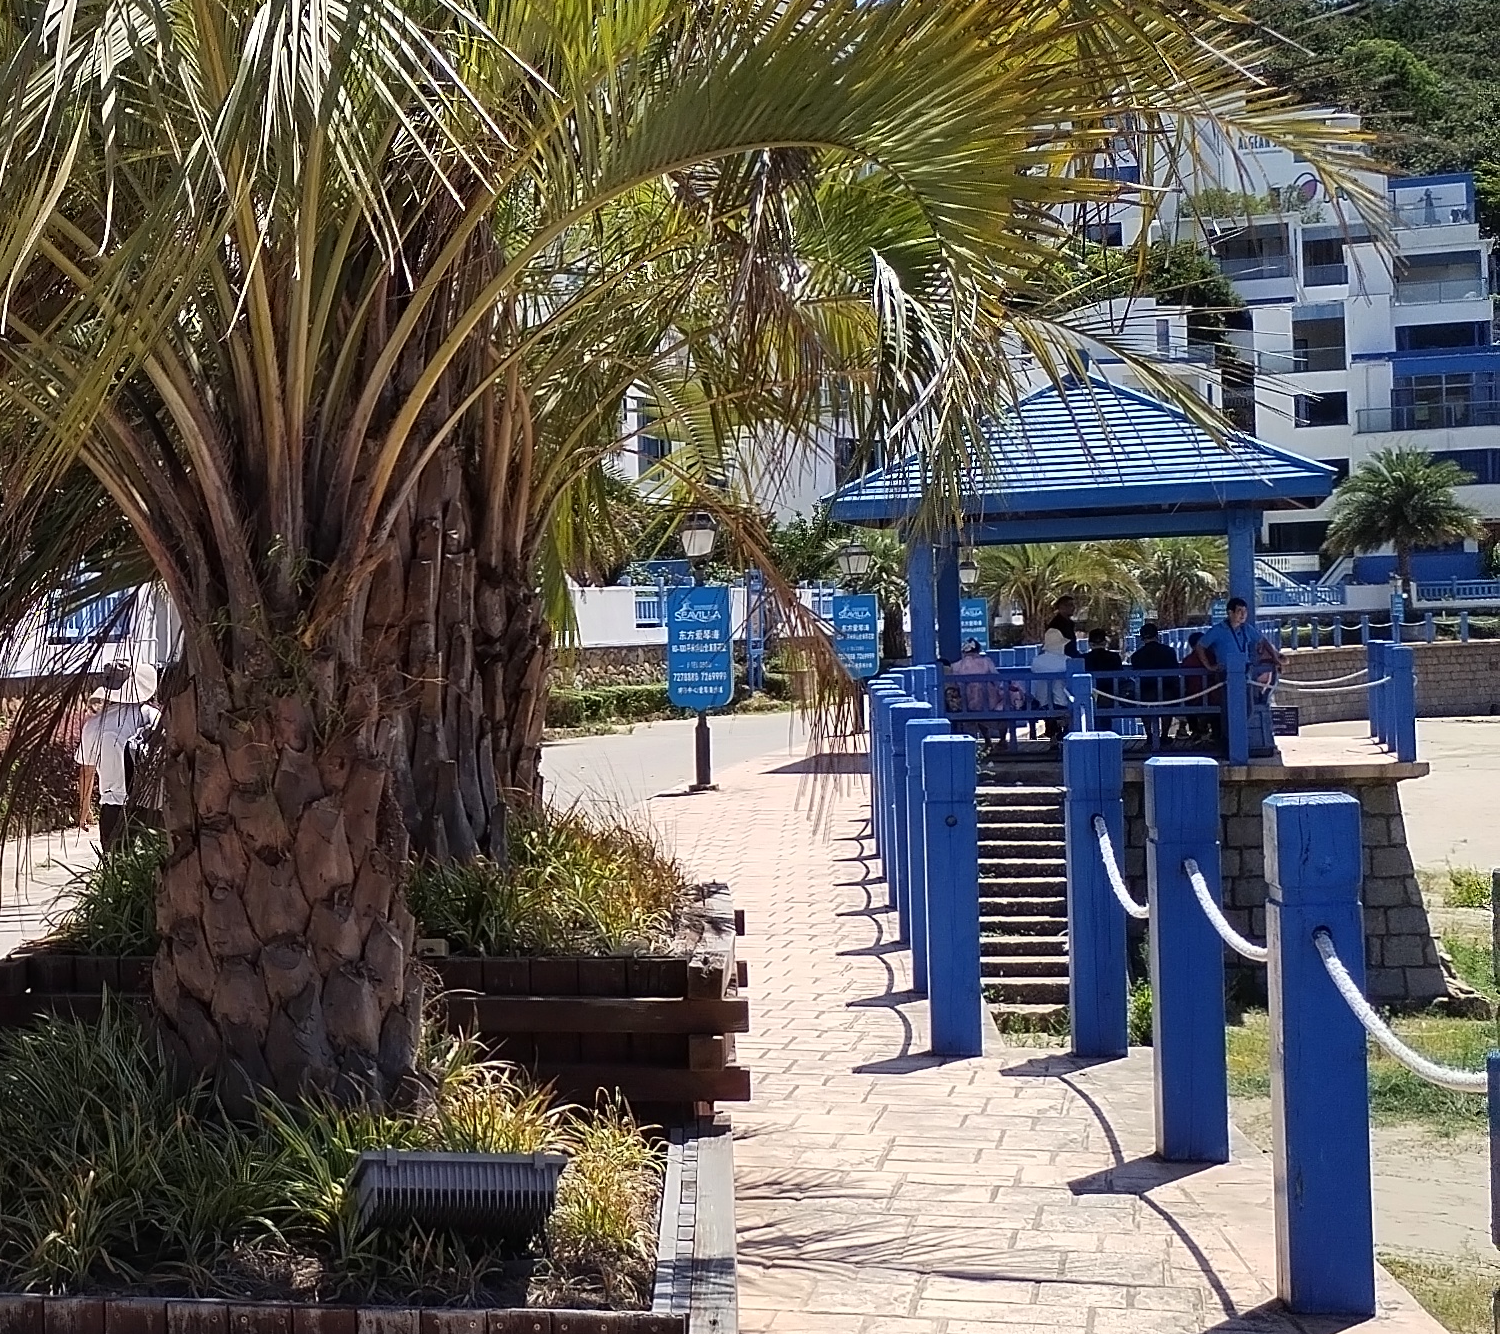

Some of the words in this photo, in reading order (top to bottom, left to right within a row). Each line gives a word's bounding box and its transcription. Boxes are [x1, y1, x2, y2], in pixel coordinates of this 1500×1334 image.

[674, 610, 721, 622] SEAVILLA
[678, 629, 720, 640] 东方爱琴海
